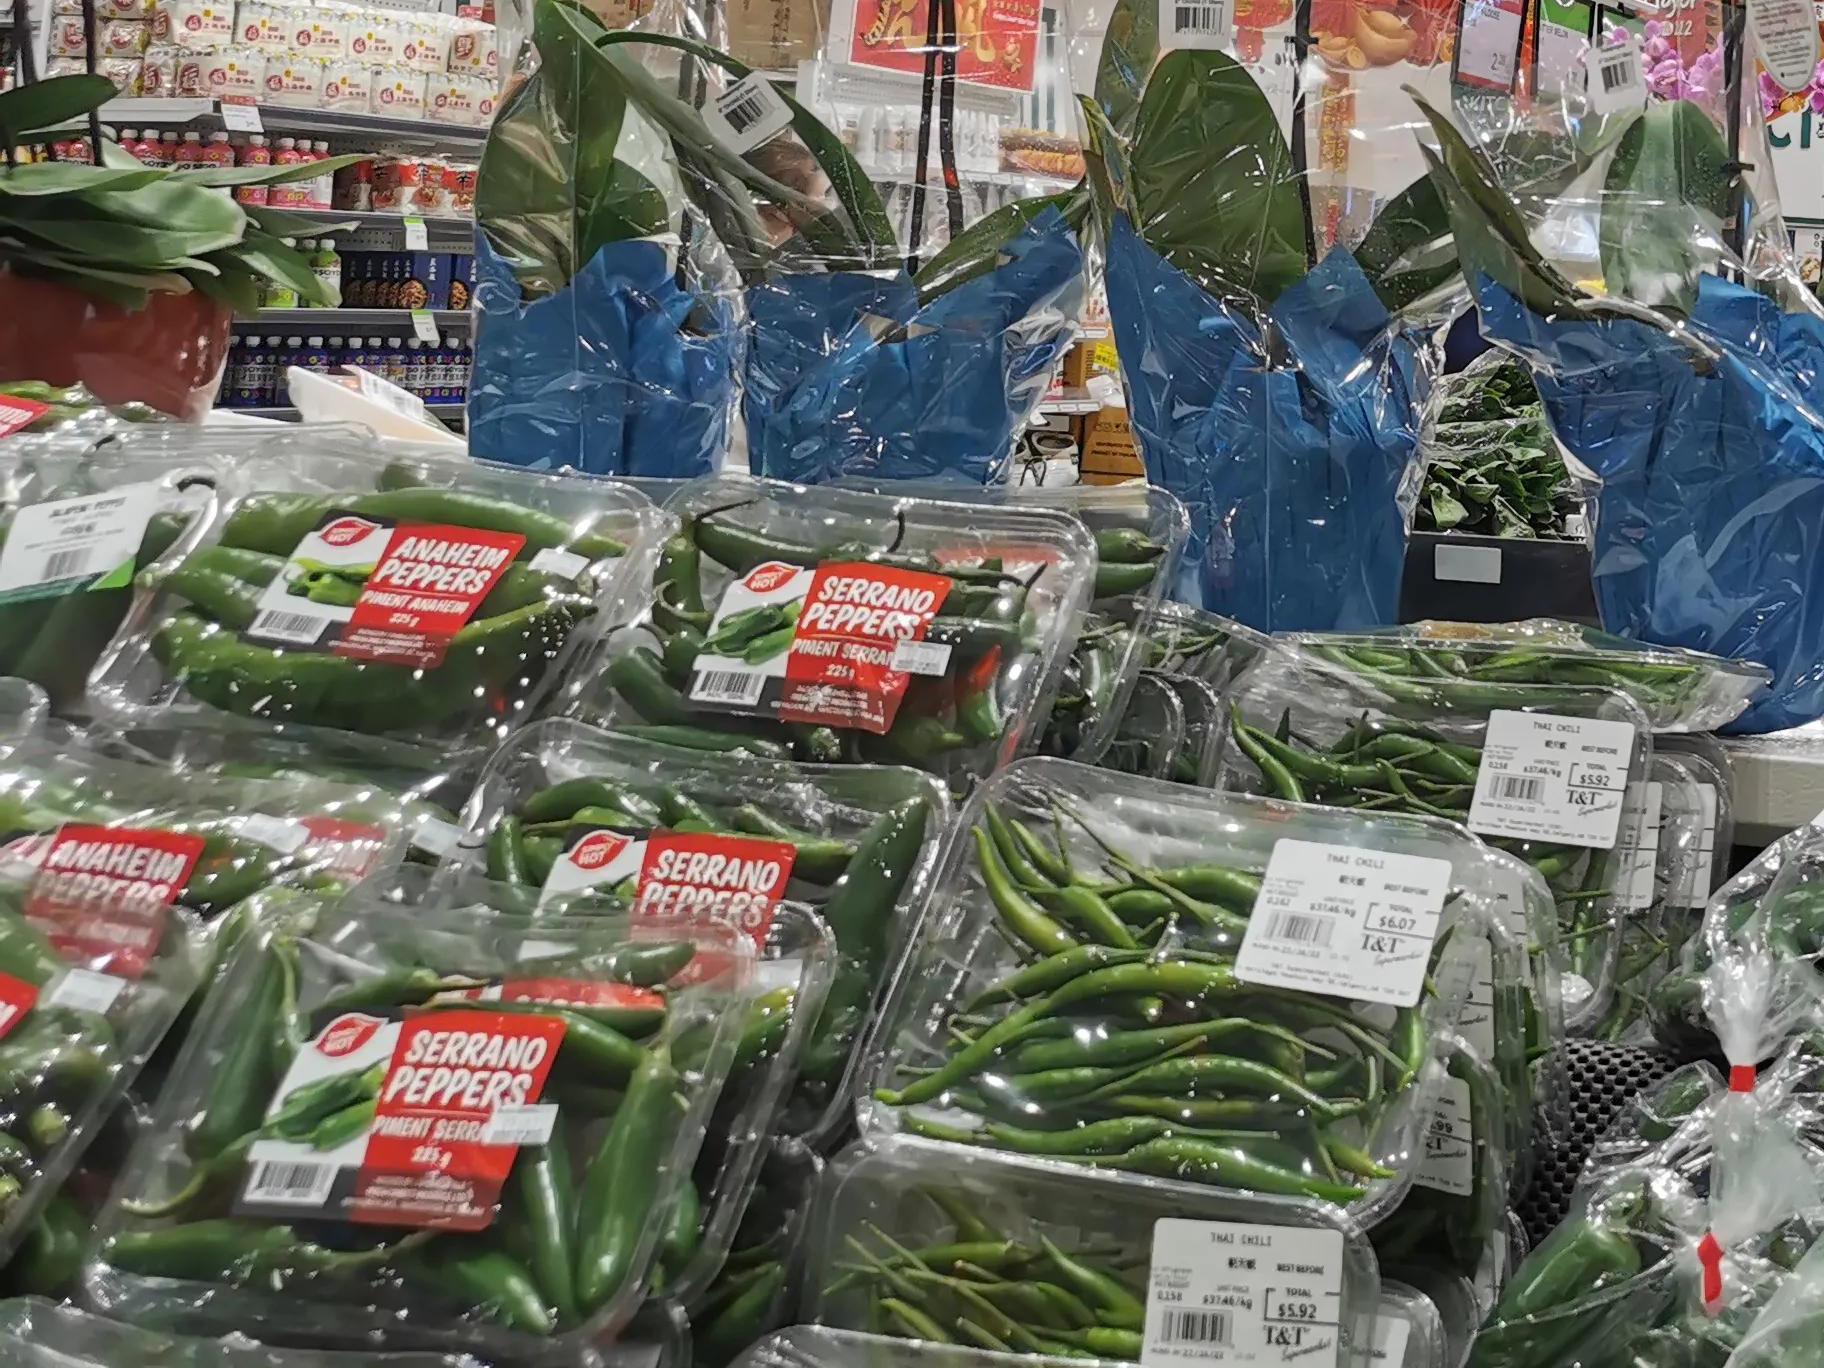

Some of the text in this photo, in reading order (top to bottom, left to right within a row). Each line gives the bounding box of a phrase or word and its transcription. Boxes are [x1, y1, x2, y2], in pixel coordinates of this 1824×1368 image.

[398, 535, 512, 571] ANAHEIM
[373, 559, 493, 596] PEPPERS
[360, 589, 470, 616] PIMENT ANAHEIM
[817, 575, 936, 616] SERRANO
[800, 603, 922, 642] PEPPERS
[791, 638, 896, 668] PIMENT SERRAN
[1578, 773, 1611, 787] $5.92
[1565, 789, 1603, 806] T&T
[48, 839, 189, 884] ANAHEIM
[653, 848, 782, 896] SERRANO
[33, 869, 172, 916] PEPPERS
[1379, 915, 1417, 931] $6.07
[1361, 933, 1406, 954] T&T
[405, 1028, 548, 1072] SERRANO
[384, 1065, 534, 1109] PEPPERS
[370, 1114, 432, 1140] PIMENT
[1210, 1232, 1273, 1248] THAI CHILI
[1284, 1287, 1312, 1298] TOTAL
[1277, 1303, 1317, 1320] $5.92
[1263, 1325, 1312, 1347] T&T
